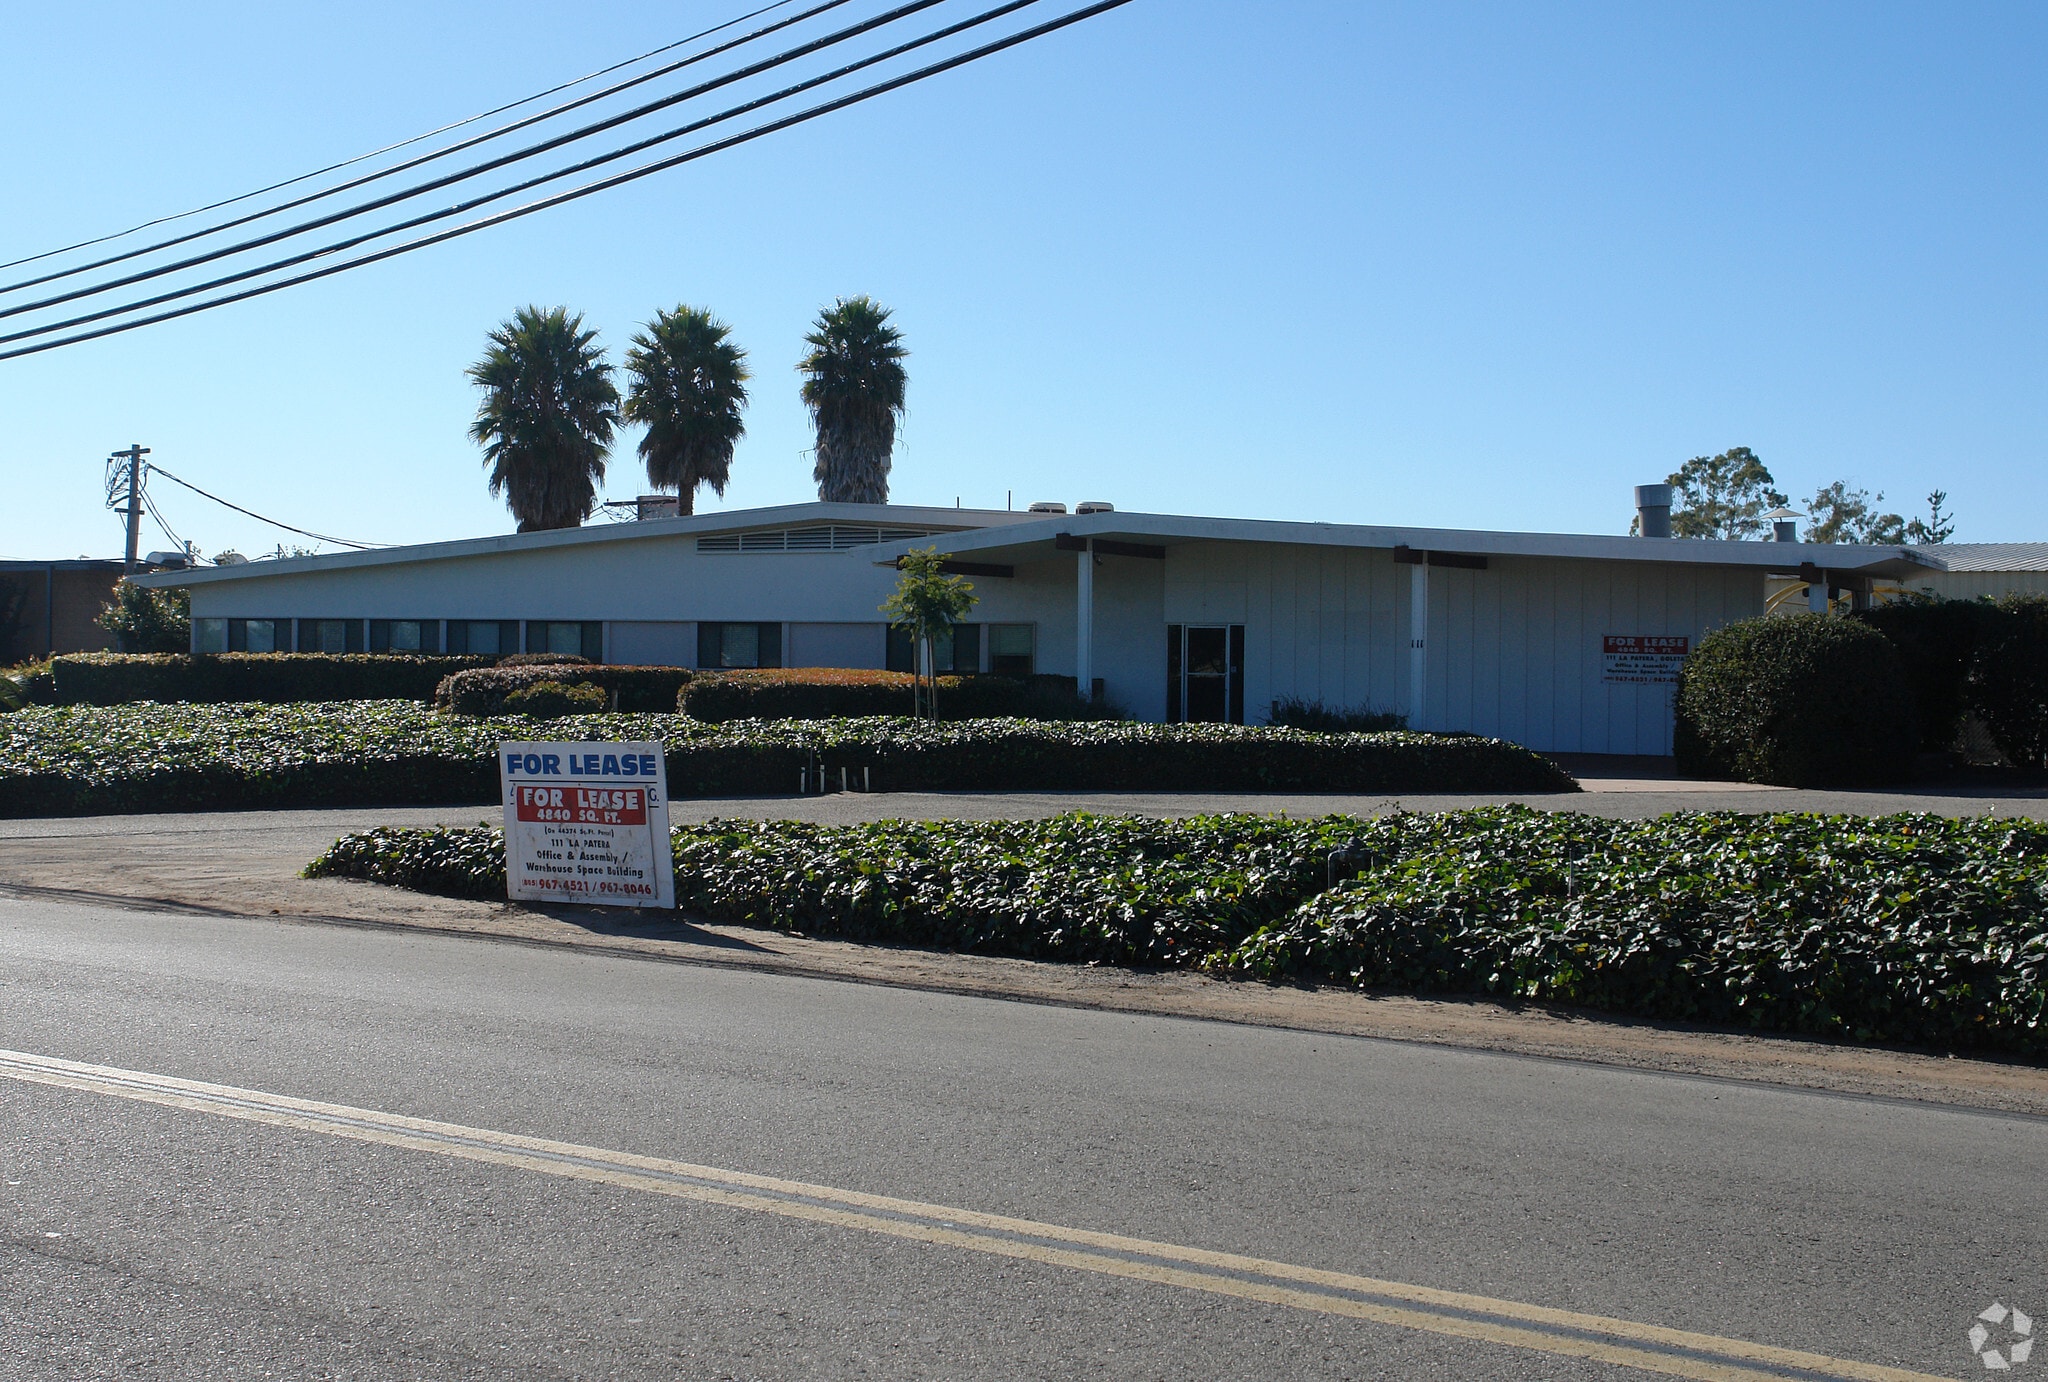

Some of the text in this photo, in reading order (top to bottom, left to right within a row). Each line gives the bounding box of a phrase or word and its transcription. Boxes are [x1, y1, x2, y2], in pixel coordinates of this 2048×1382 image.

[1608, 637, 1685, 647] FOR LEASE
[506, 754, 657, 776] FOR LEASE
[523, 788, 564, 807] FOR
[576, 789, 640, 810] LEASE
[537, 808, 622, 823] 4840 SQ. FT.
[551, 839, 610, 848] 111 LA PATERA
[536, 850, 628, 865] Office & Assembly /
[526, 862, 644, 879] Warehouse Space Building
[539, 879, 589, 892] 967-4521
[592, 882, 597, 892] /
[600, 883, 651, 895] 967-8046
